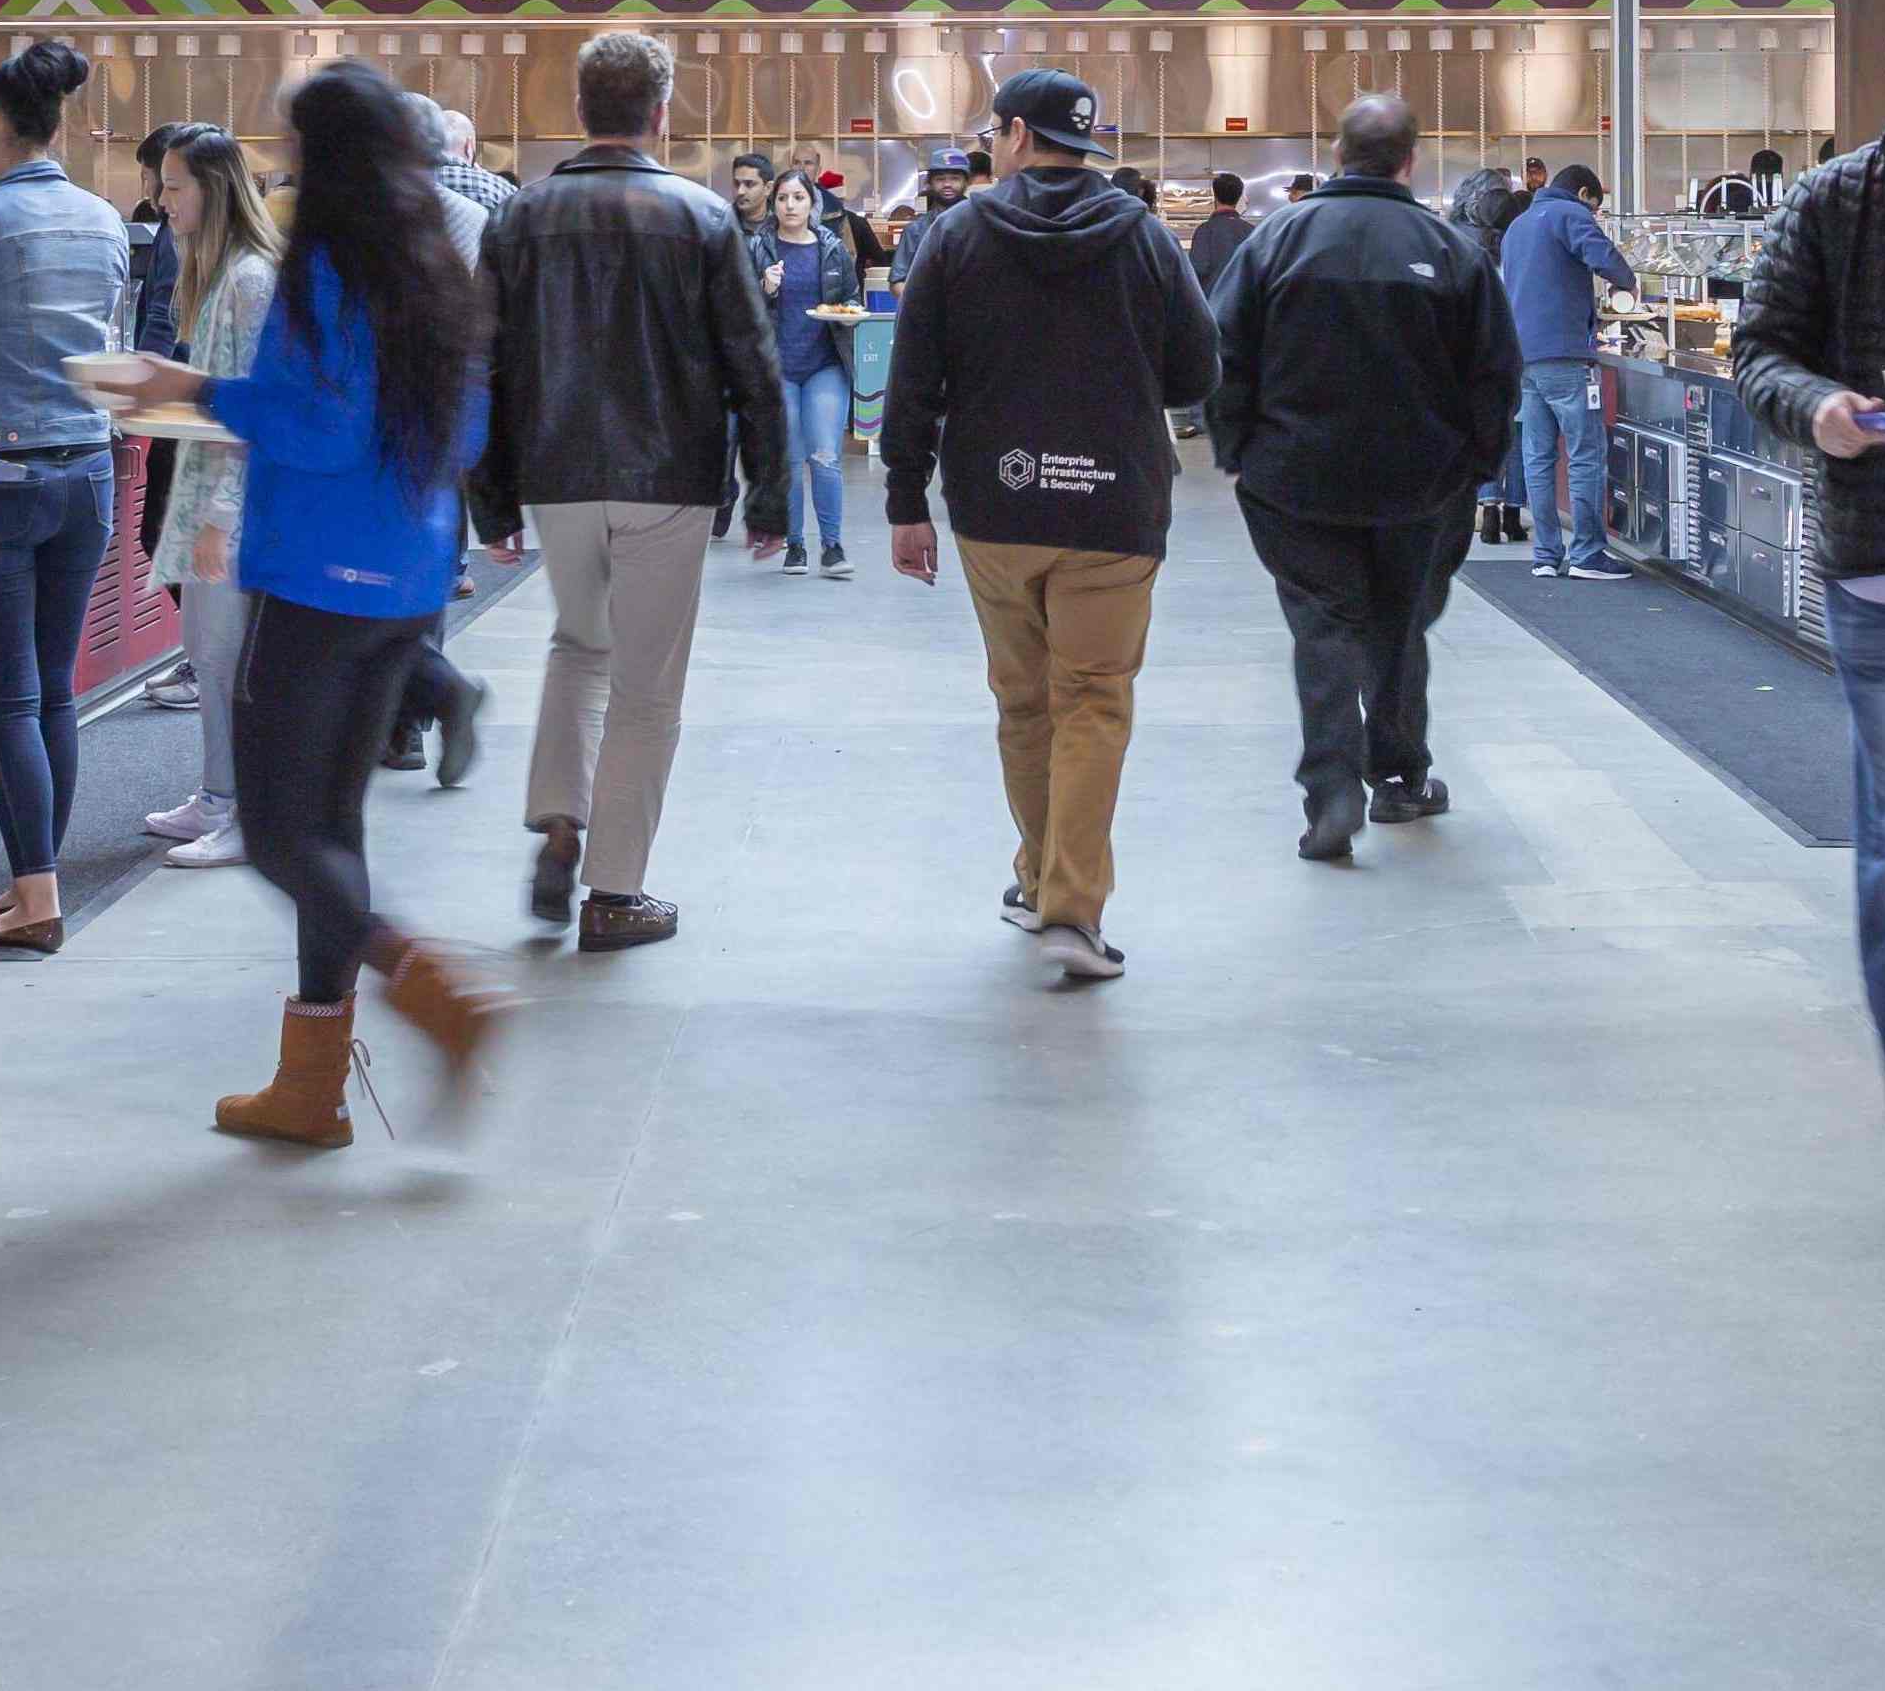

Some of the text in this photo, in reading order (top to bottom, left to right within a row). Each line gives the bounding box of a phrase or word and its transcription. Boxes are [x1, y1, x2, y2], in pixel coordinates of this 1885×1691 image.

[1041, 453, 1095, 468] Enterprise
[1040, 465, 1117, 482] Infrastructure
[1039, 477, 1096, 495] & Security
